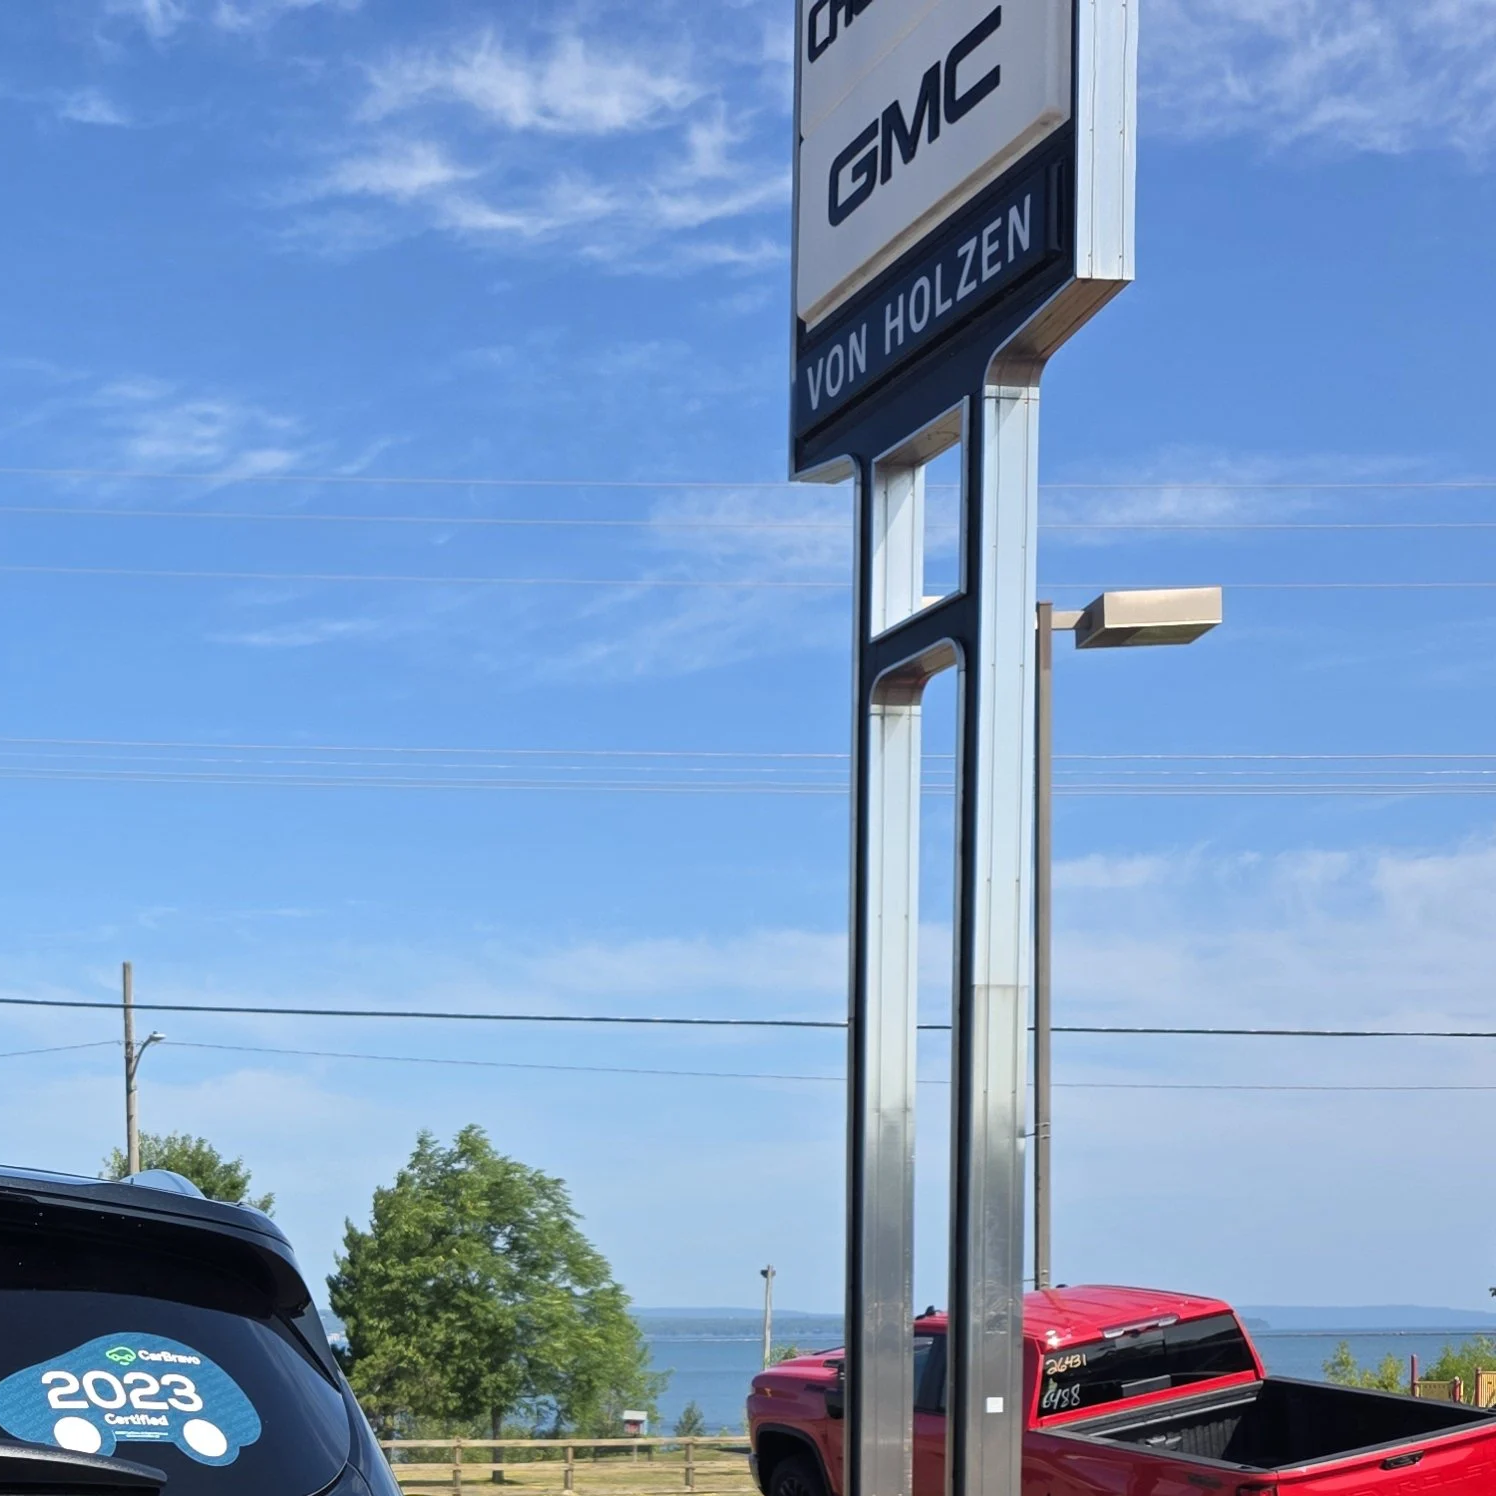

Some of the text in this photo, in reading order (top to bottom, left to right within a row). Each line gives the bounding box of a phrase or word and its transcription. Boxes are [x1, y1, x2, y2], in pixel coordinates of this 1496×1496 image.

[828, 4, 1002, 227] GMC
[807, 193, 1032, 411] VON HOLZEN
[138, 1349, 201, 1365] CarBravo
[1045, 1353, 1087, 1375] 26431
[41, 1370, 203, 1412] 2023
[104, 1413, 170, 1426] Certified
